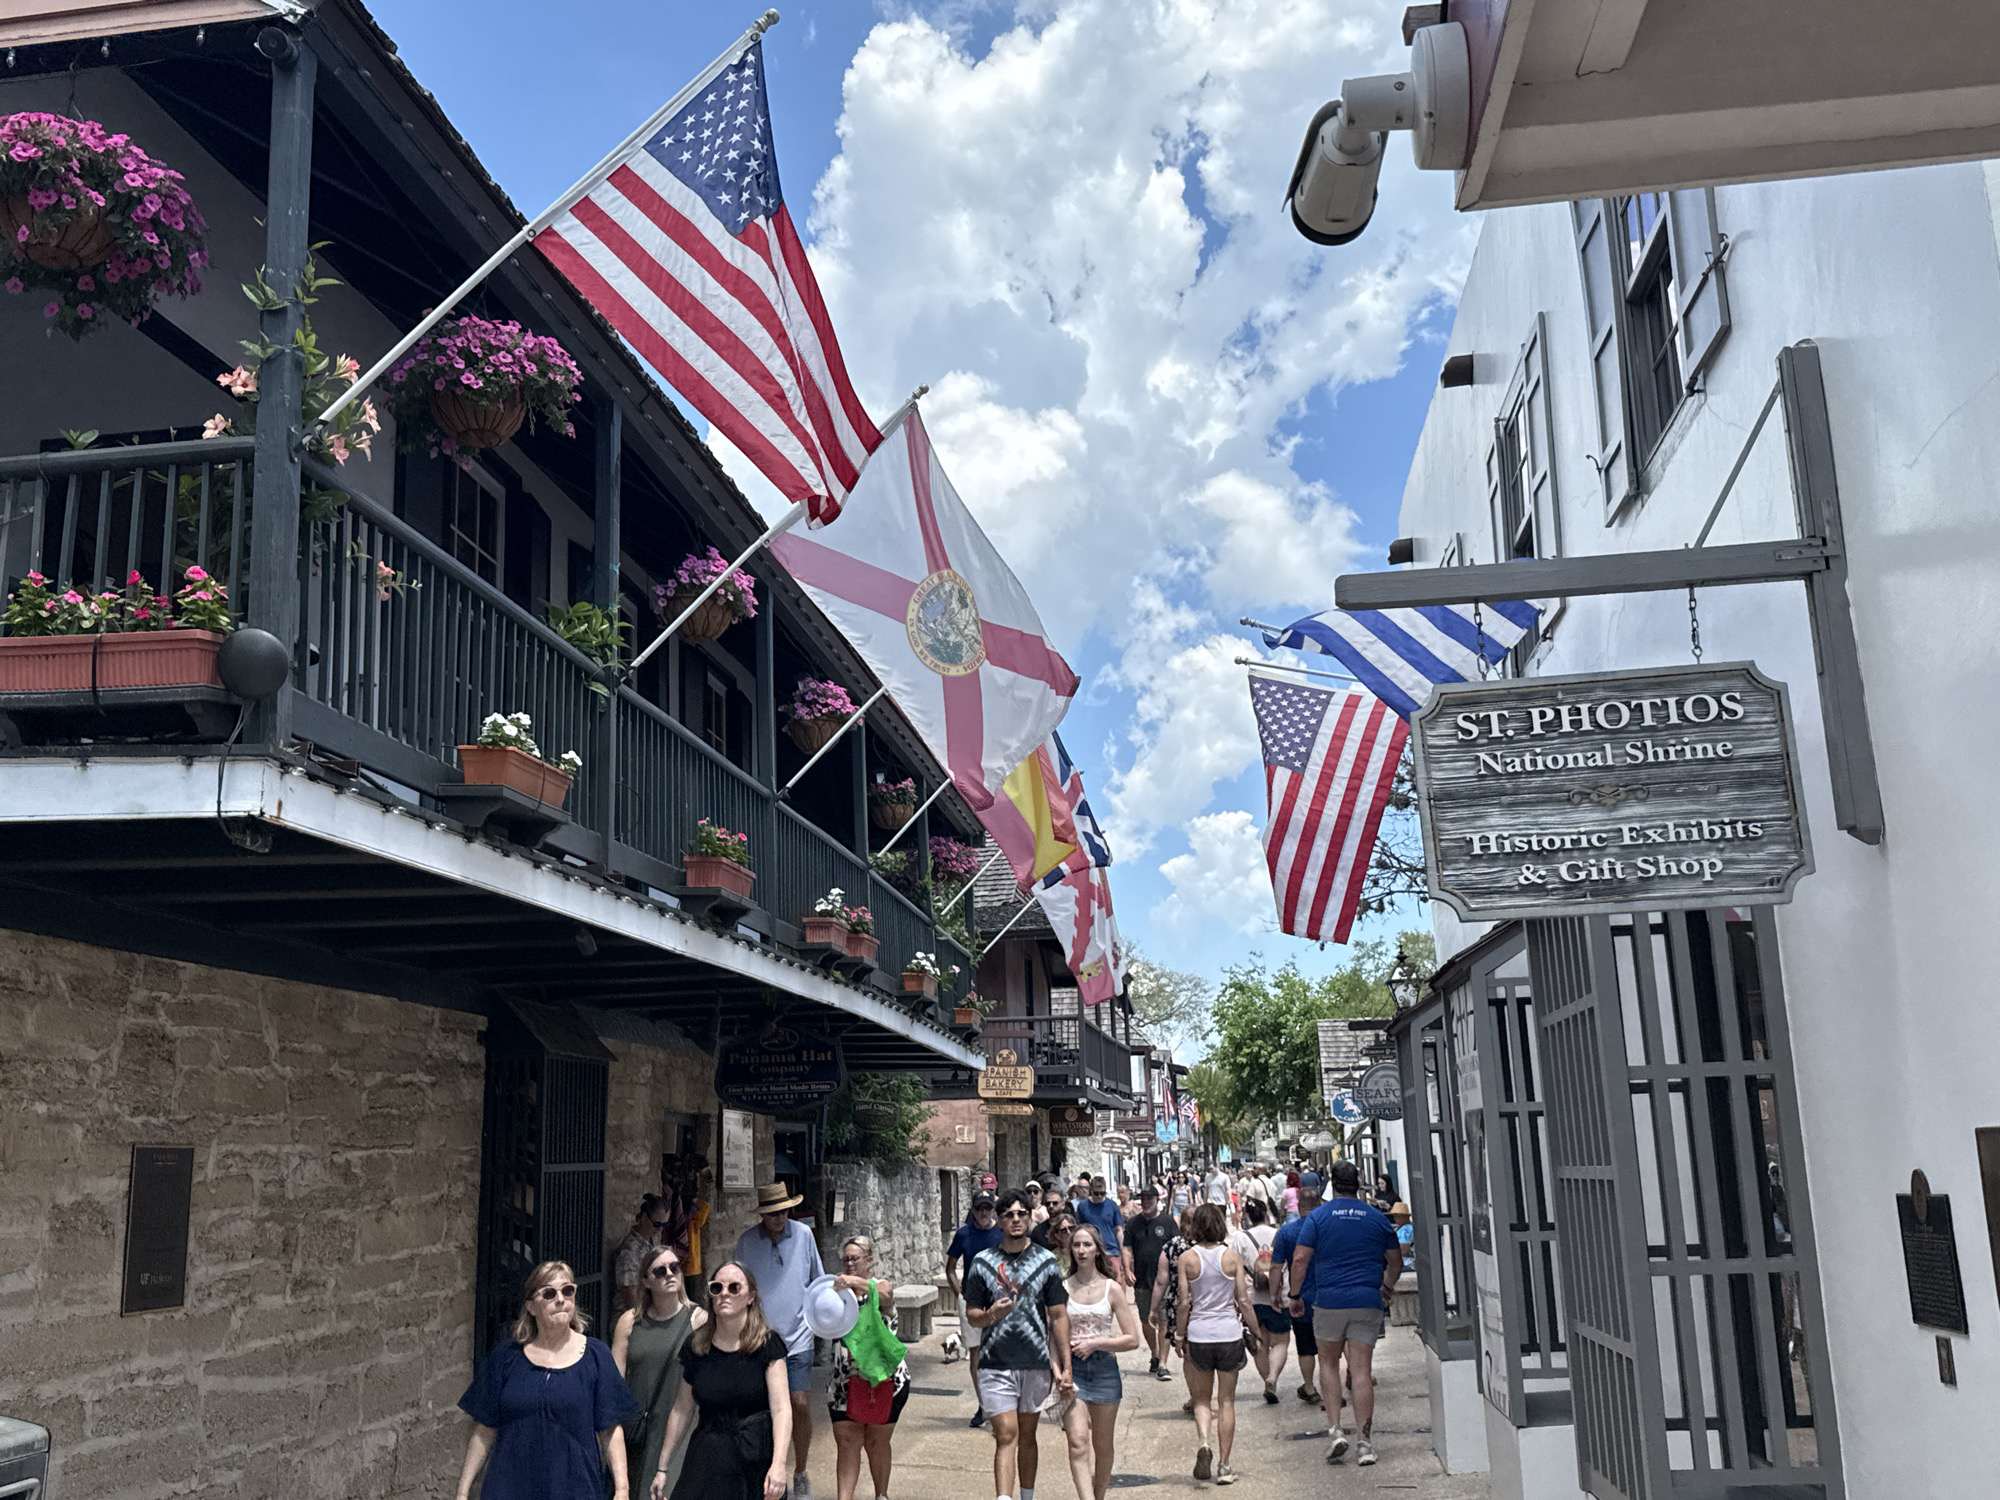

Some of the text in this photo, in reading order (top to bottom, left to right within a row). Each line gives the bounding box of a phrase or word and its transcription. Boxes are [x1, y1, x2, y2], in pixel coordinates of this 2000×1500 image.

[913, 578, 936, 604] GREAT
[909, 618, 951, 673] IN GOD WE TRUST
[1456, 691, 1745, 741] ST. PHOTIOS
[1475, 736, 1735, 775] National Shrine
[1466, 818, 1763, 856] Historic Exhibits
[1517, 854, 1724, 886] & Gift Shop
[729, 1049, 833, 1064] Panama Hat
[750, 1063, 811, 1074] Company
[983, 1067, 1026, 1078] SPANISH
[985, 1078, 1024, 1088] BAKERY
[1356, 1088, 1400, 1098] SEAFO
[1052, 1121, 1093, 1129] WHETSTONE
